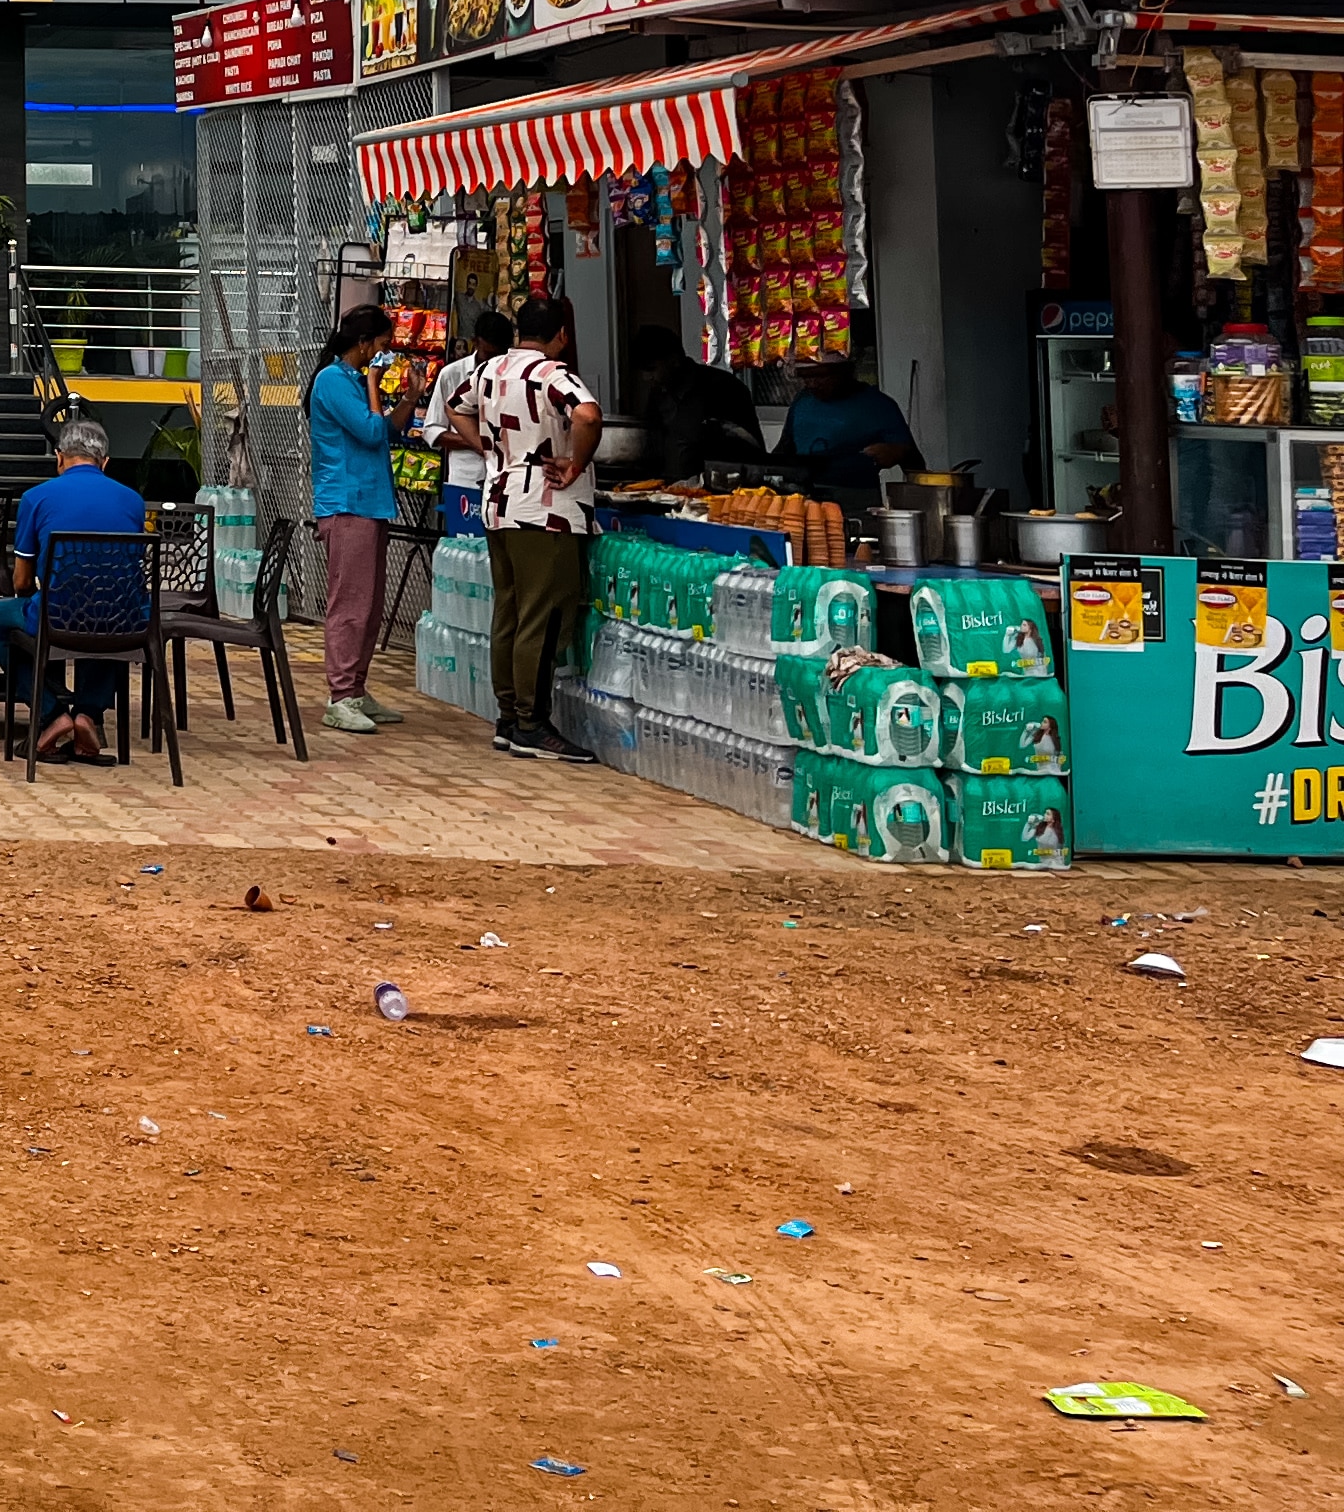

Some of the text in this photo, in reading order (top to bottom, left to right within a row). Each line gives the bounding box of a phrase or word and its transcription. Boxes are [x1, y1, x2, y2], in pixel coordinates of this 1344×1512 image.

[313, 69, 332, 82] PASTA
[961, 610, 1003, 630] Bisleri
[982, 707, 1025, 726] Bisleri
[982, 798, 1027, 816] Bisleri
